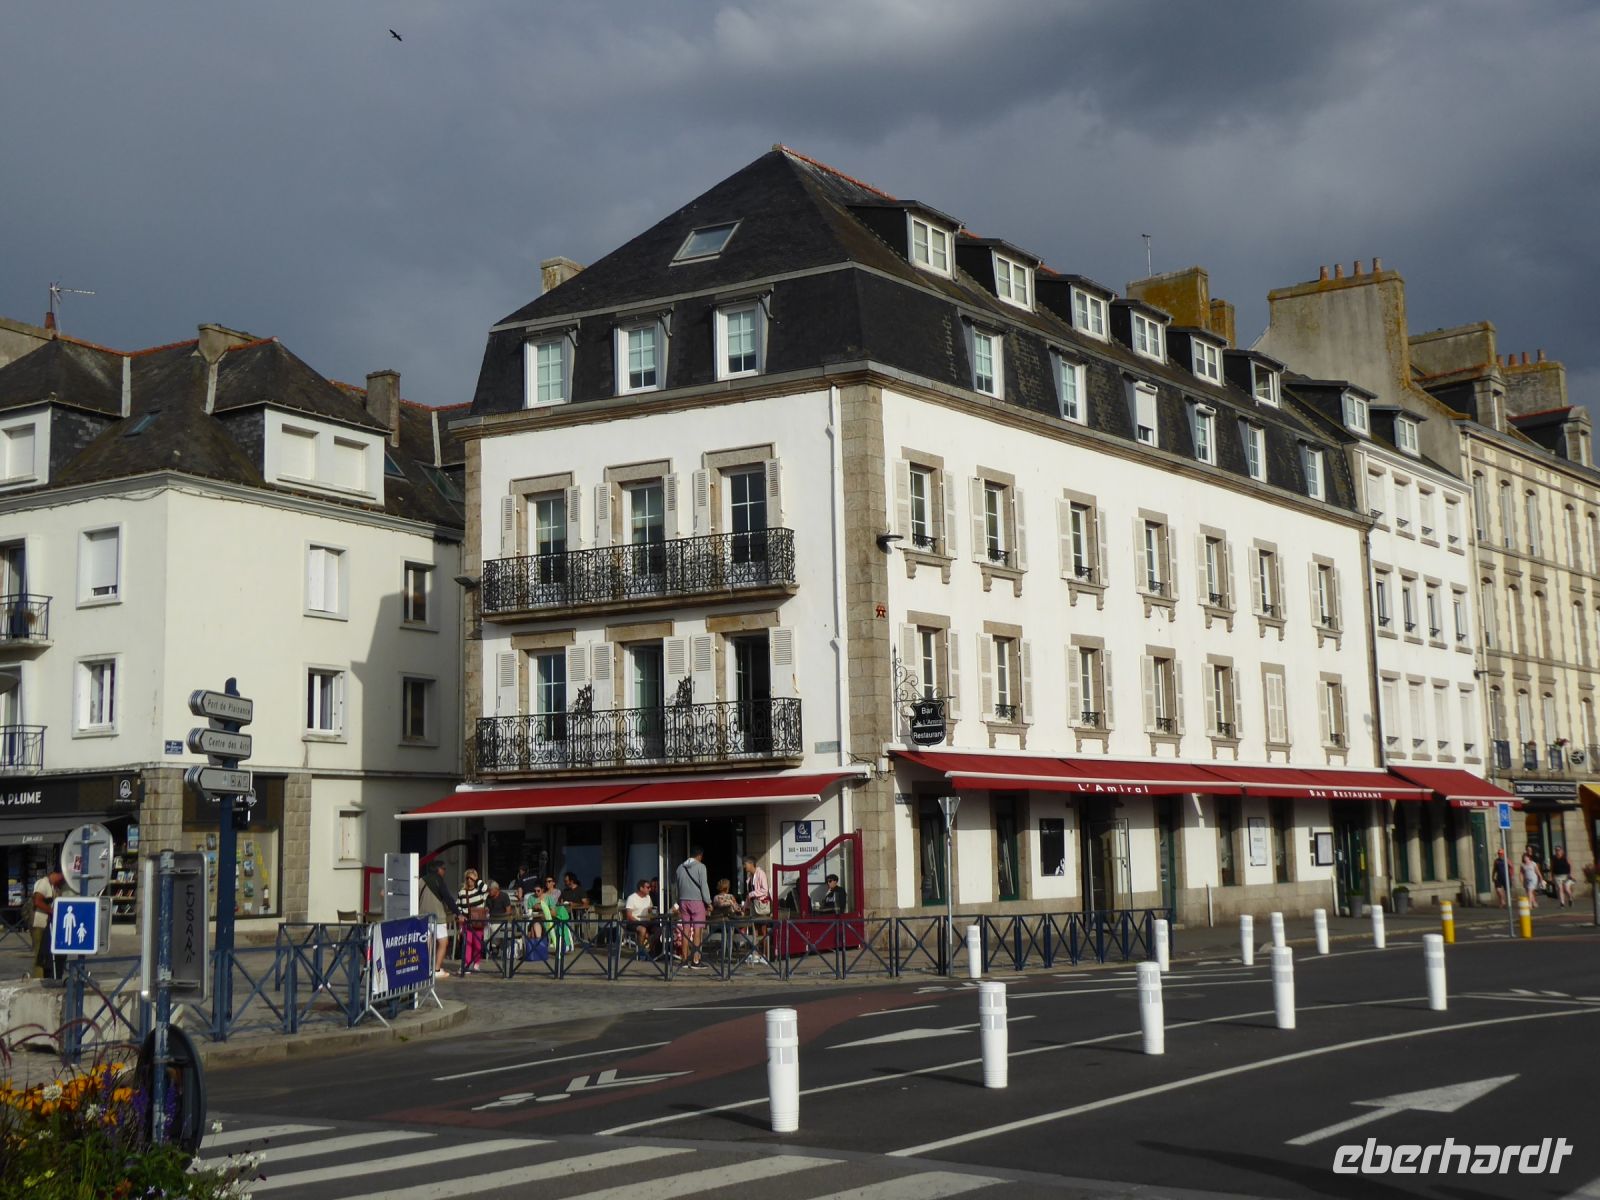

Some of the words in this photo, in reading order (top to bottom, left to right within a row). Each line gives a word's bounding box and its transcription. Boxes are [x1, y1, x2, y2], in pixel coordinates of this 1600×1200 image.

[207, 698, 218, 709] Port
[228, 702, 251, 715] Plaisance
[913, 731, 943, 739] Restaurant
[208, 737, 225, 748] Centre
[228, 741, 236, 750] des
[1078, 783, 1149, 793] L'Amiral
[8, 791, 42, 805] PLUME
[1332, 790, 1382, 799] RESTAURANT
